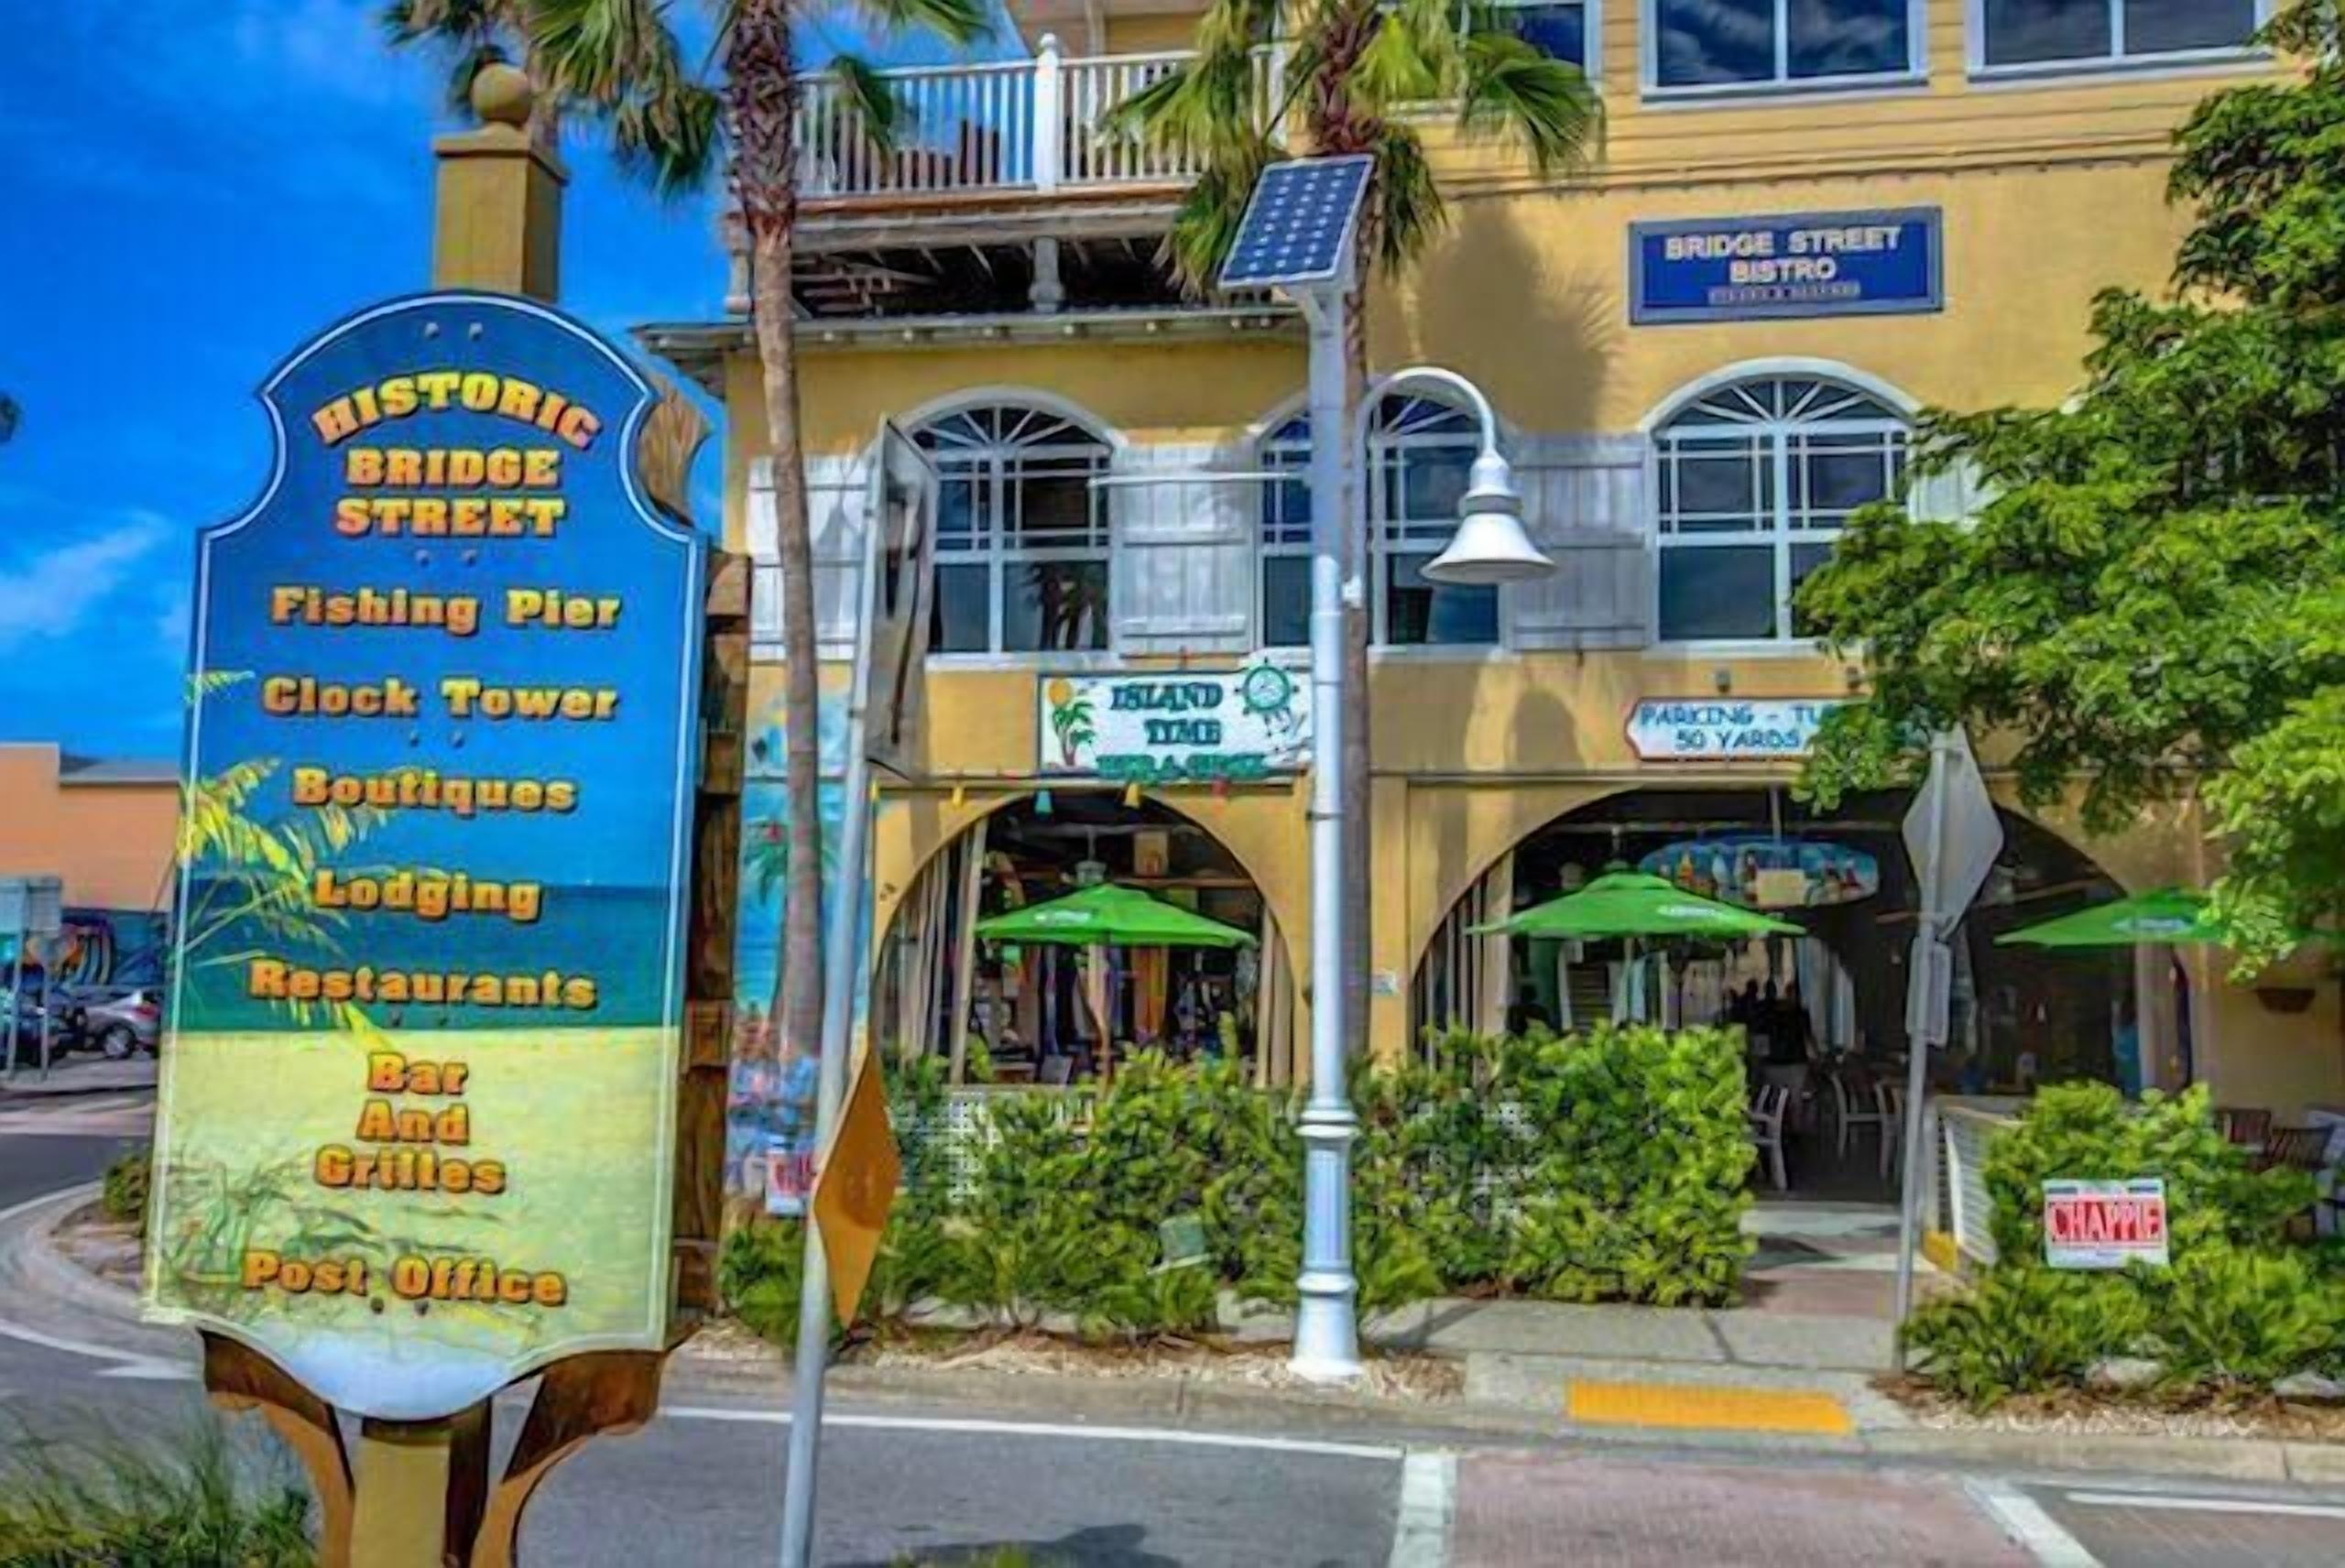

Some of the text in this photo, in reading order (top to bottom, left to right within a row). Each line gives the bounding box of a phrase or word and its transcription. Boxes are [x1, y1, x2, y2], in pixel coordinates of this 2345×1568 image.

[1665, 226, 1901, 259] BRIDGE STREET
[1730, 256, 1837, 283] BISTRO
[312, 371, 602, 450] HISTORIC
[346, 447, 562, 489] BRIDGE
[336, 497, 565, 537] STREET
[270, 586, 622, 636] Fishing Pier
[262, 677, 620, 720] Clock Tower
[1640, 703, 1756, 727] PARKING
[1715, 728, 1800, 749] YARDS
[291, 768, 577, 816] Boutiques
[315, 868, 542, 923] Lodging
[248, 958, 598, 1009] Restaurants
[368, 1052, 469, 1095] Bar
[356, 1100, 470, 1146] And
[315, 1145, 507, 1194] Grilles
[245, 1249, 567, 1306] Post Office
